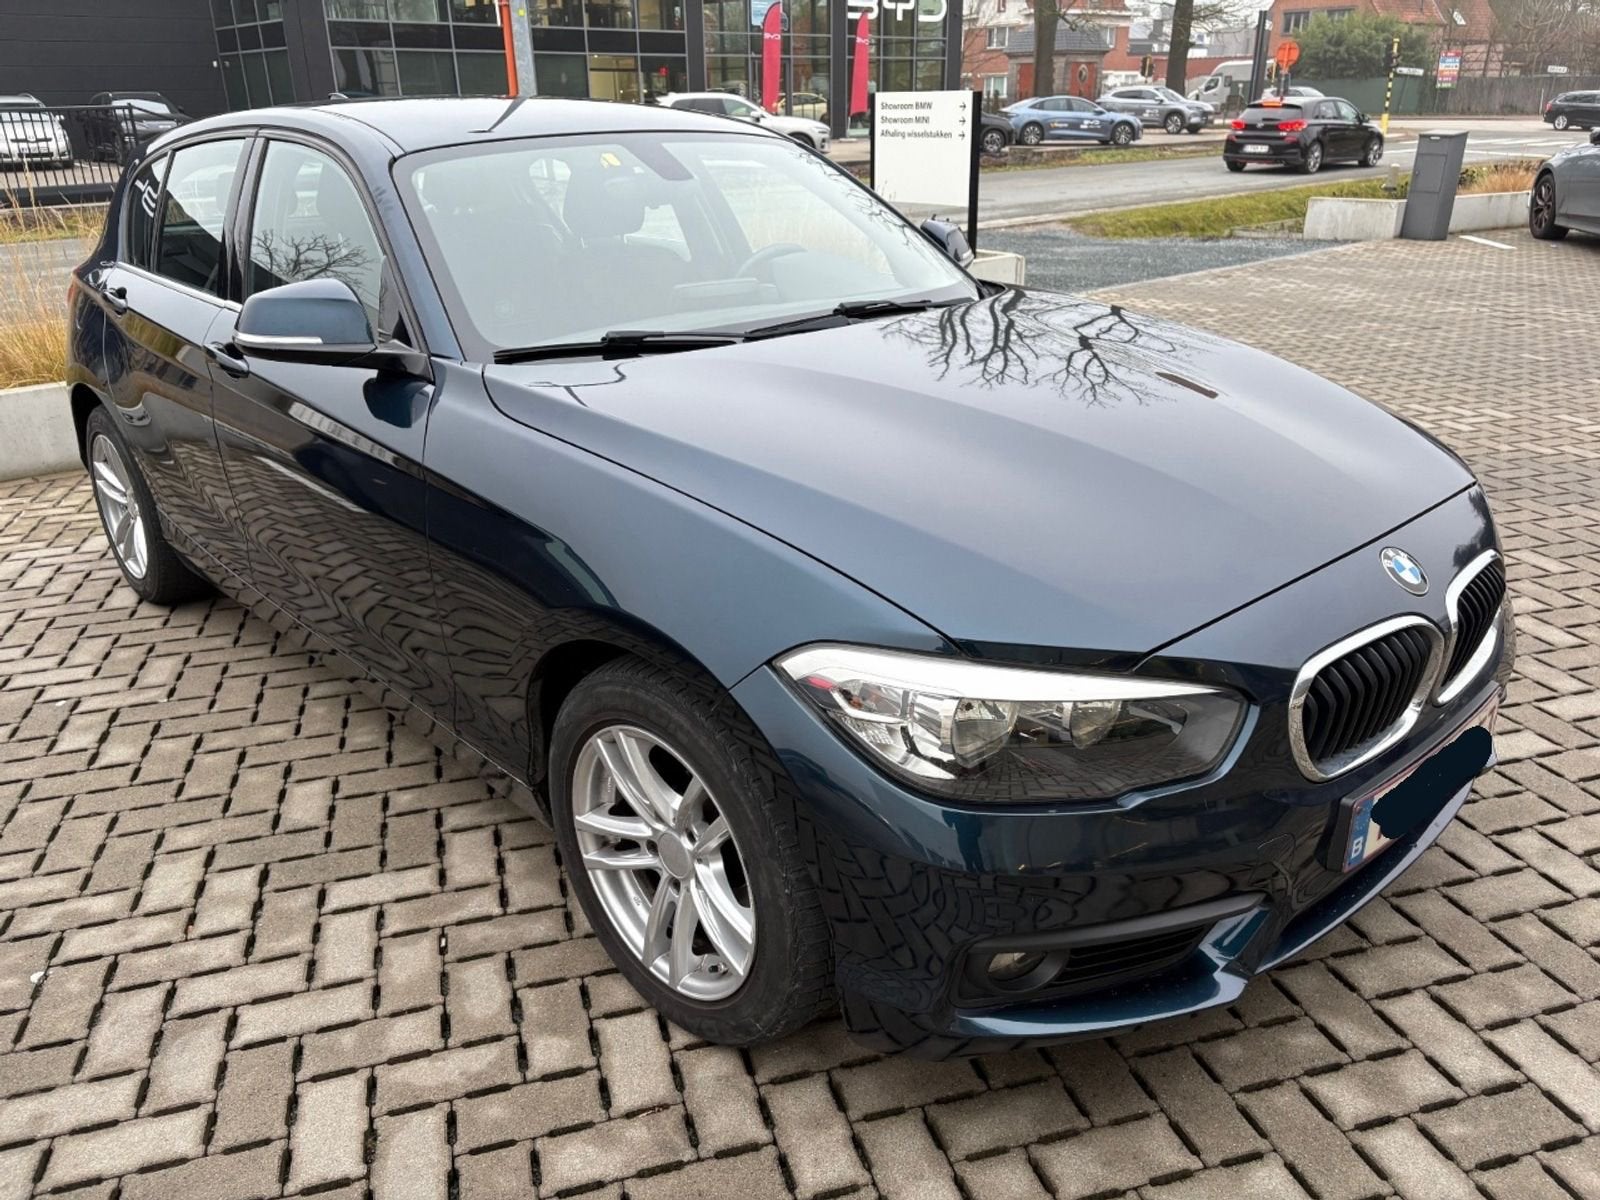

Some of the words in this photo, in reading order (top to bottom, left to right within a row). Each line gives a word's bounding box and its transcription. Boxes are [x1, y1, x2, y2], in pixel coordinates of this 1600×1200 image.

[880, 101, 914, 110] Showroom
[915, 101, 933, 110] BMW
[880, 115, 914, 124] Showroom
[915, 115, 930, 124] MINI
[880, 129, 906, 140] Afhaling
[907, 129, 953, 139] wisselstukken
[1351, 837, 1364, 859] B
